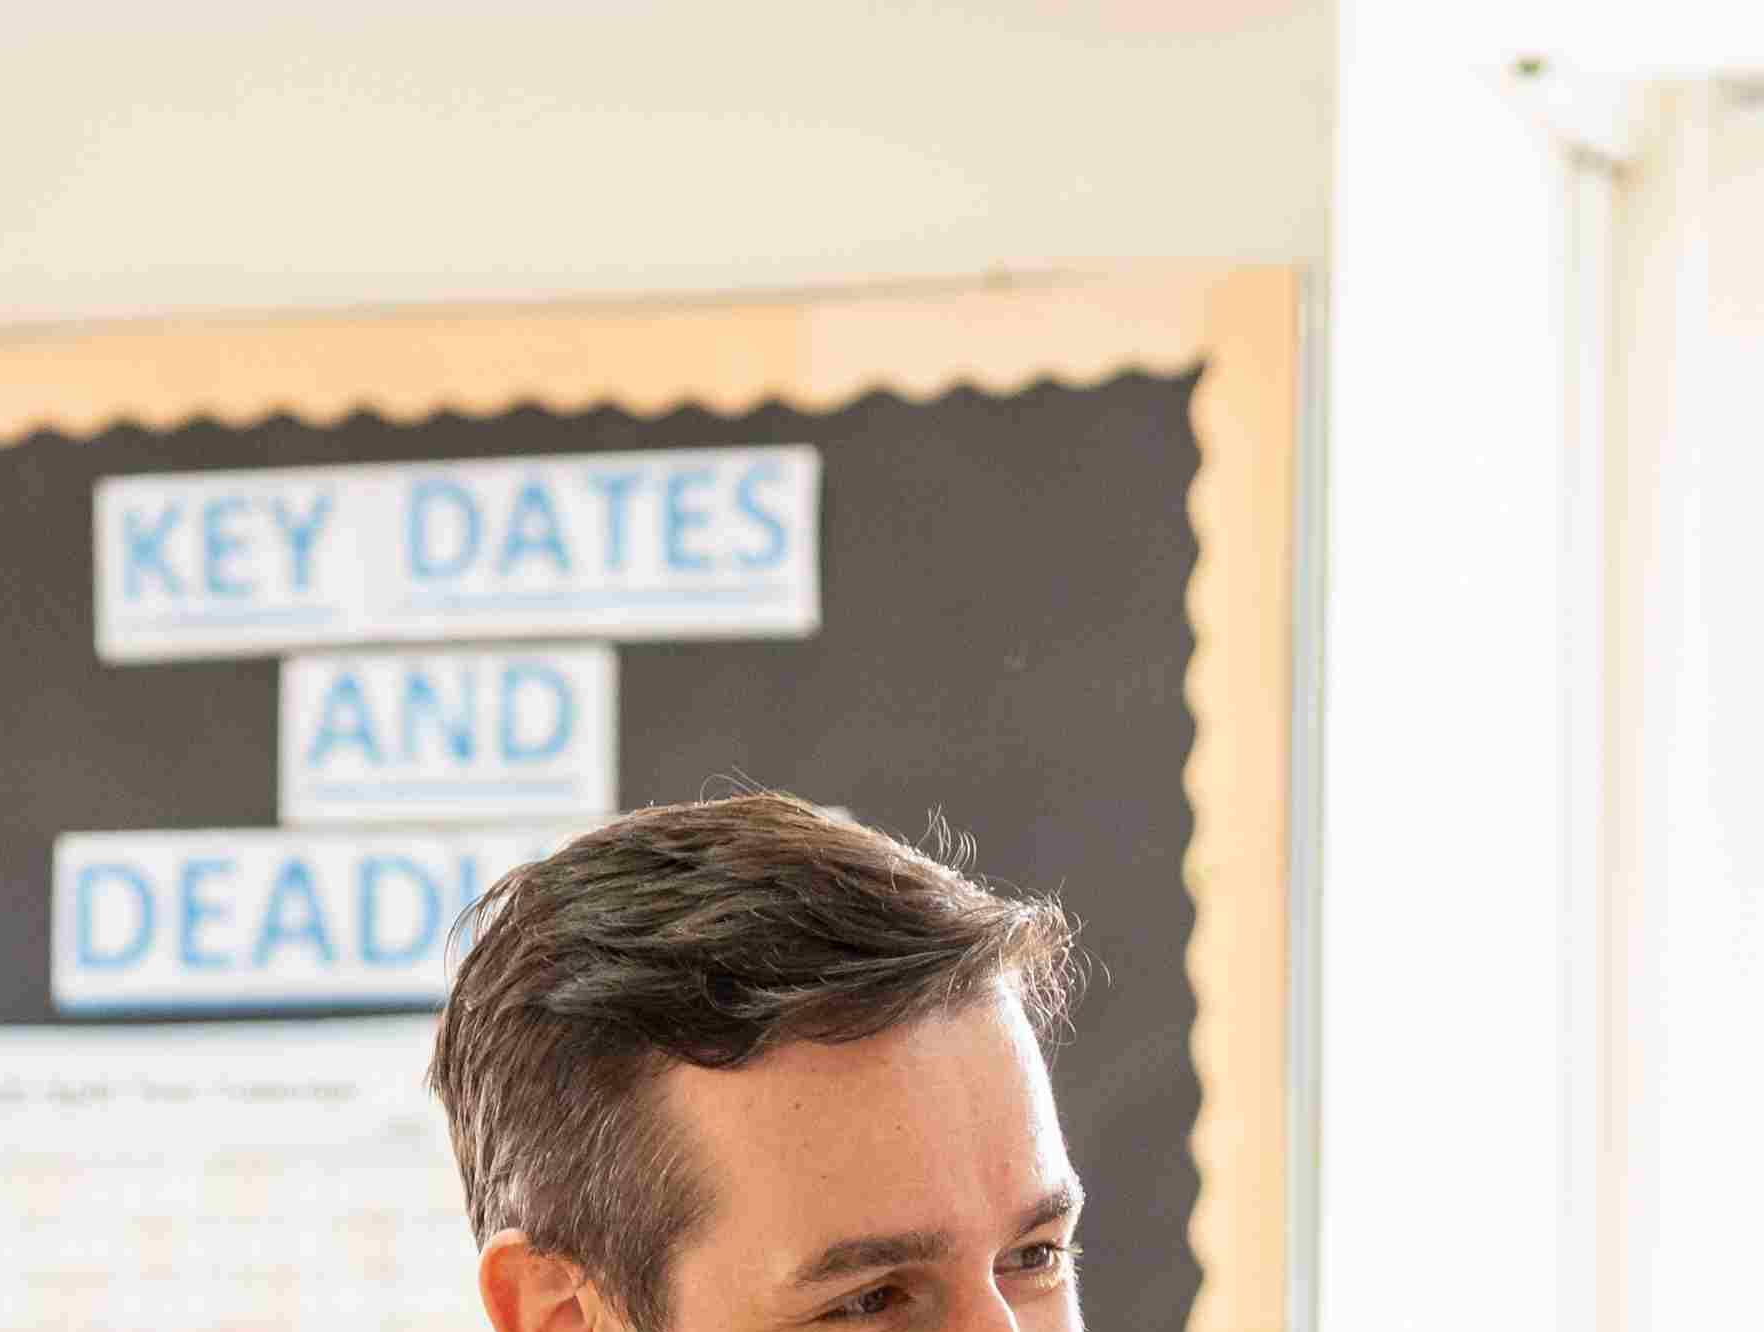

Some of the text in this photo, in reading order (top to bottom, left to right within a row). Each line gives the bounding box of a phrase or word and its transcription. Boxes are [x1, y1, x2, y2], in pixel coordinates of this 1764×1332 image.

[118, 462, 792, 599] KEY DATES
[306, 661, 577, 768] AND
[74, 853, 491, 974] DEADL
